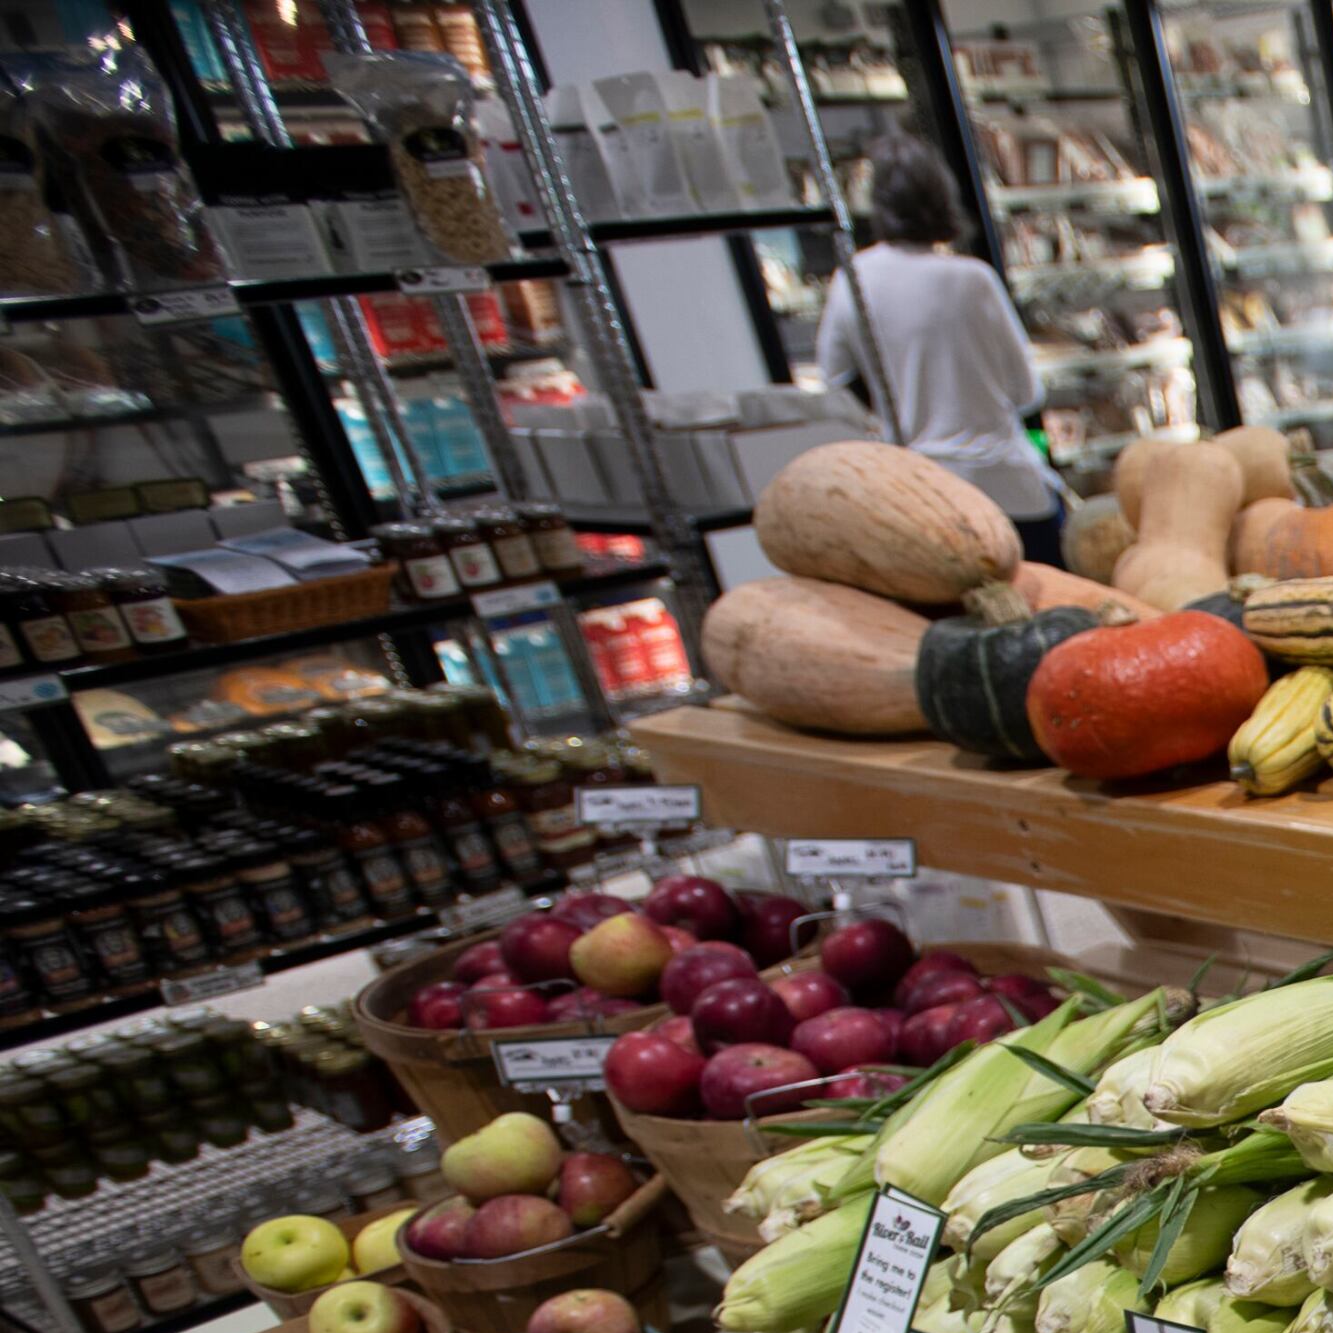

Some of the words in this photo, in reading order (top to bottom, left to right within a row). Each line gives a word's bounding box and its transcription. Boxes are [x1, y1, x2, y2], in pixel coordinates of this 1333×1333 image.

[861, 1269, 874, 1284] the
[867, 1251, 889, 1272] Bring
[891, 1264, 905, 1277] me
[907, 1268, 917, 1281] to
